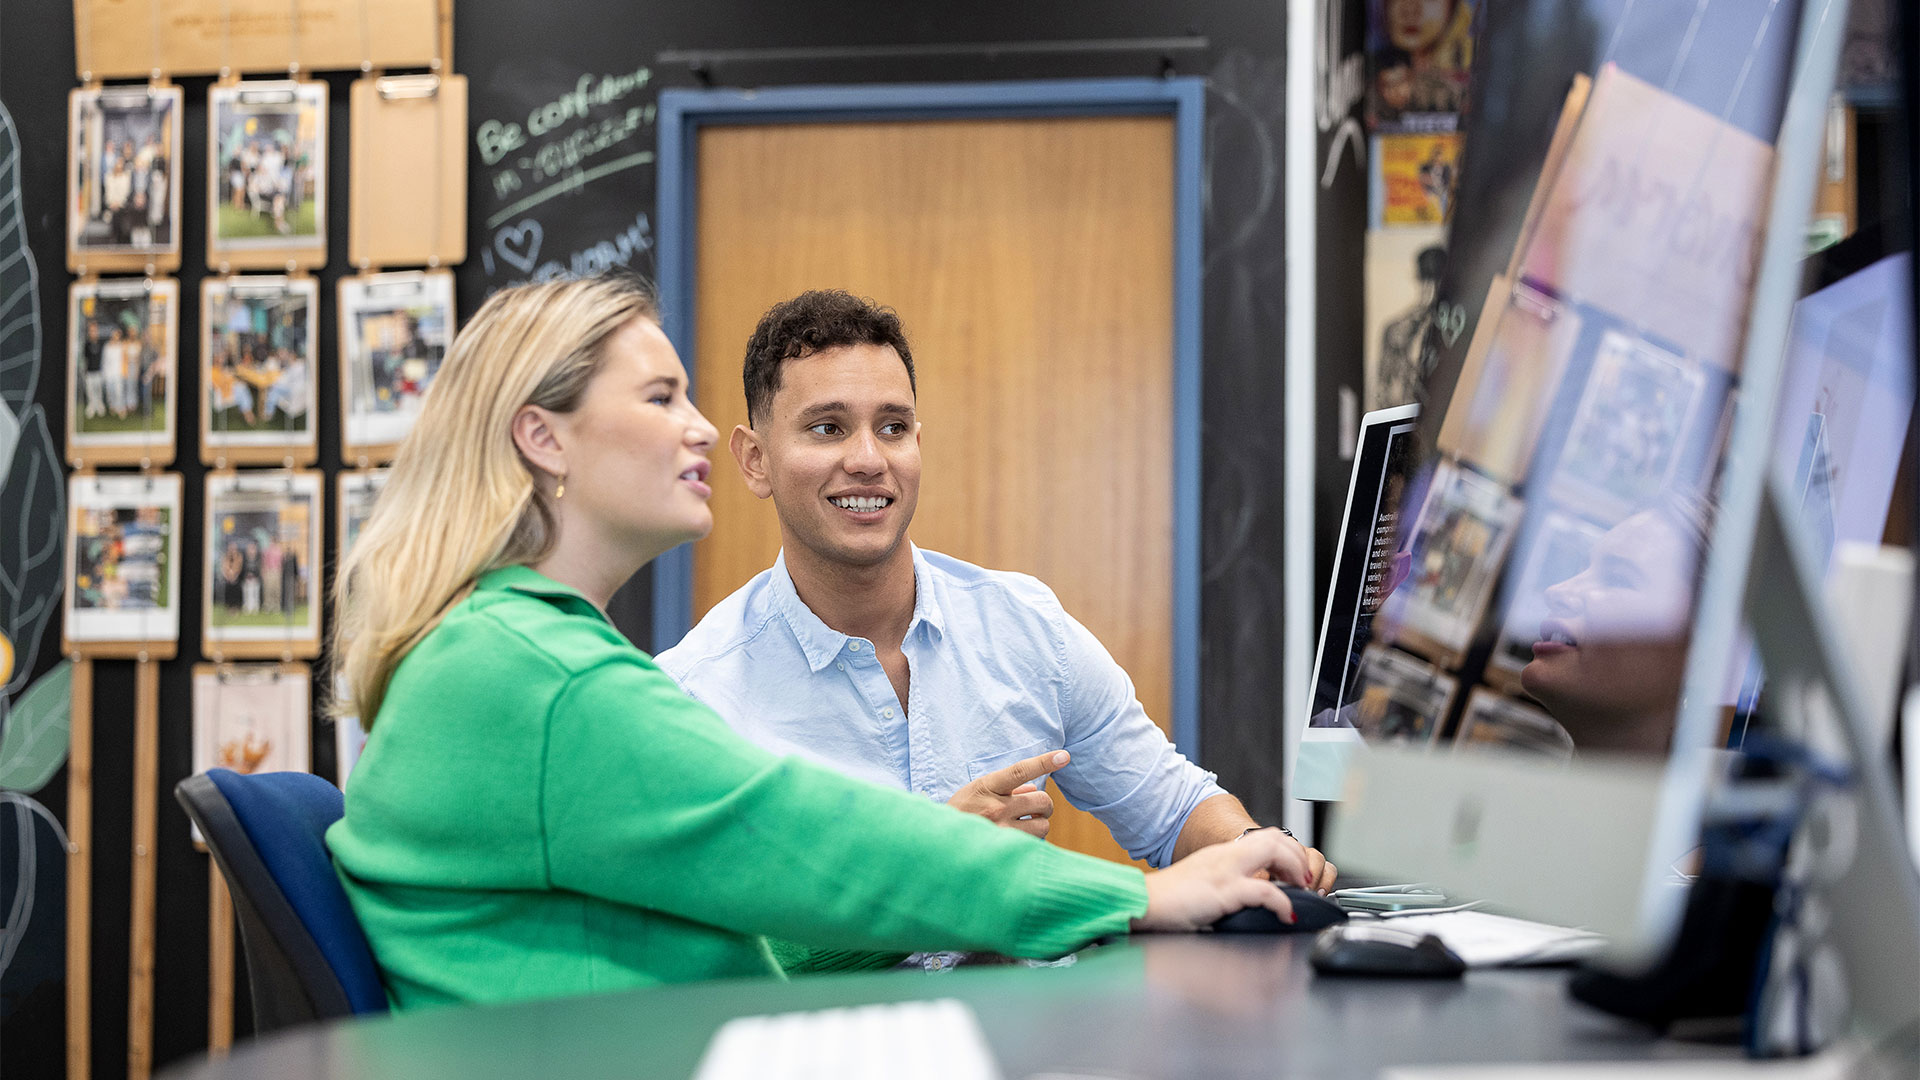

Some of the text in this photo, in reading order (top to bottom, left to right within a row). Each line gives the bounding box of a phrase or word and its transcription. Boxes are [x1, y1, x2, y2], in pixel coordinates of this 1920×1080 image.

[476, 119, 527, 166] Be
[1371, 549, 1381, 557] and
[1363, 597, 1372, 605] and
